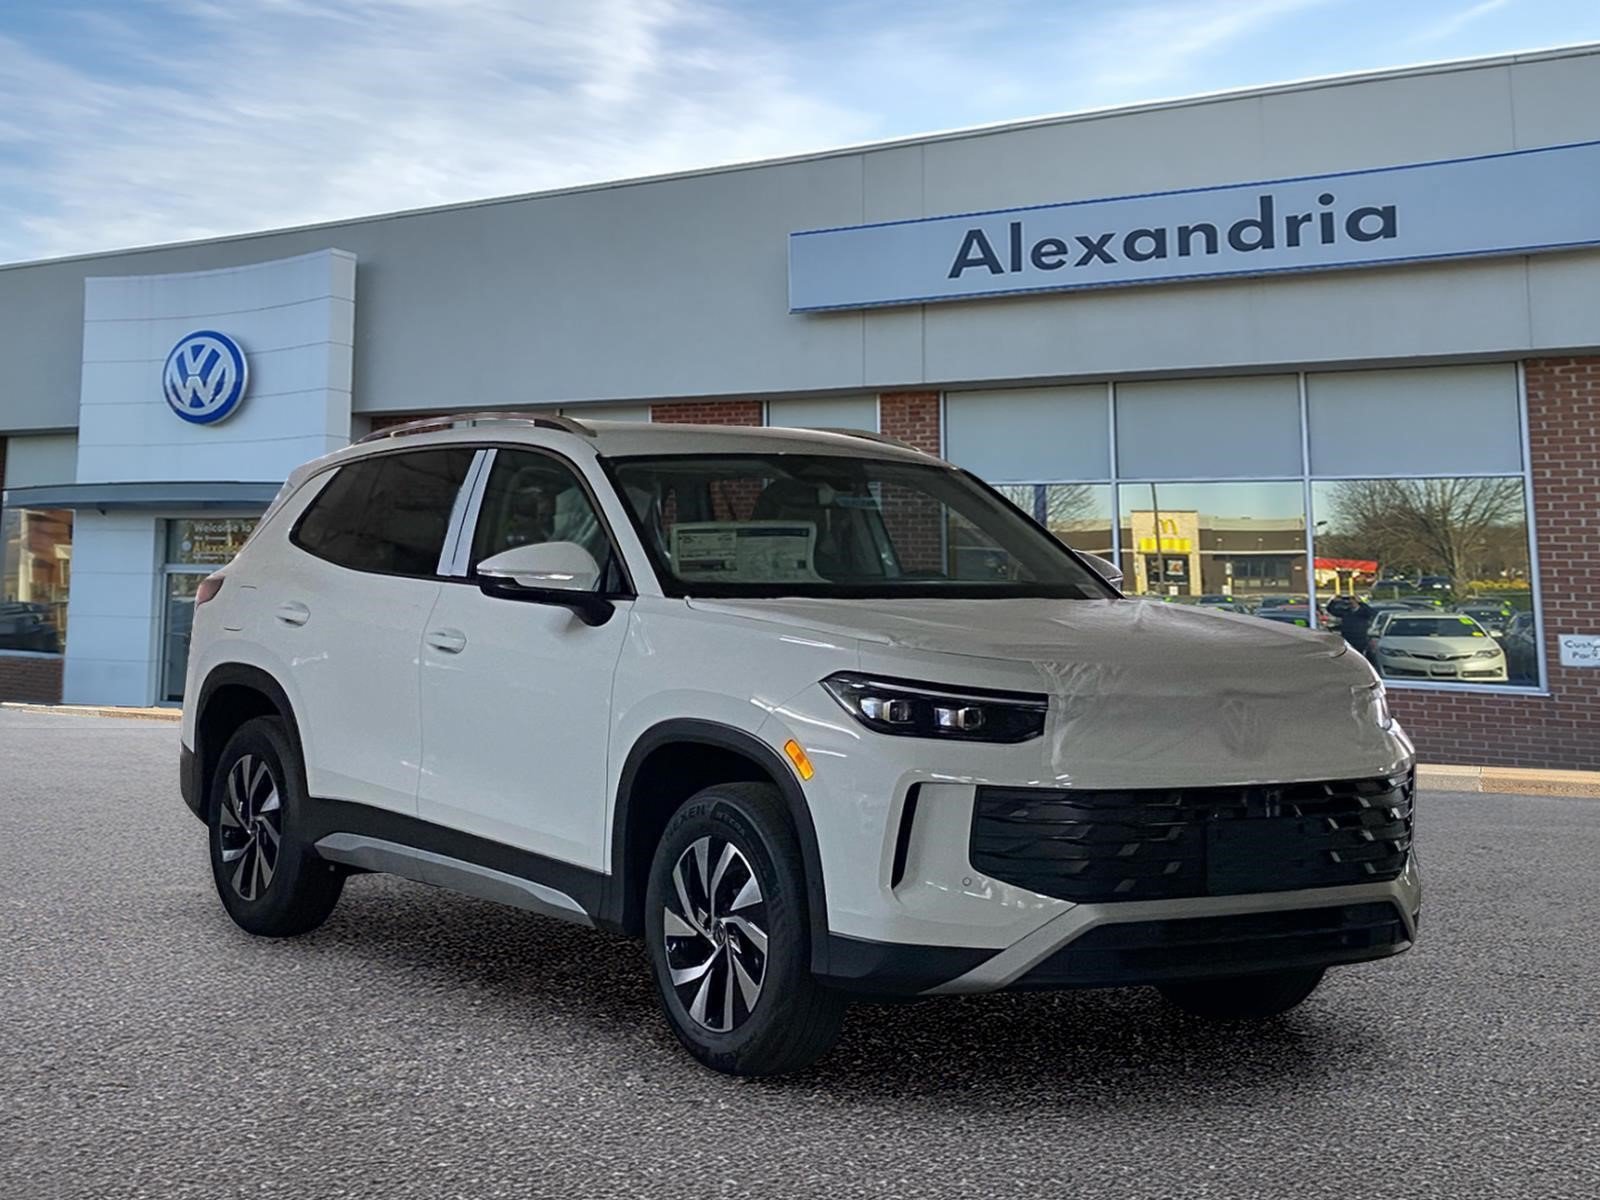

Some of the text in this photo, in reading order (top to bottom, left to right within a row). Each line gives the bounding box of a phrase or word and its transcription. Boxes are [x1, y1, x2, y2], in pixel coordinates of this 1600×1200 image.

[948, 192, 1398, 280] Alexandria
[166, 336, 238, 416] VW
[194, 521, 240, 533] Welcome
